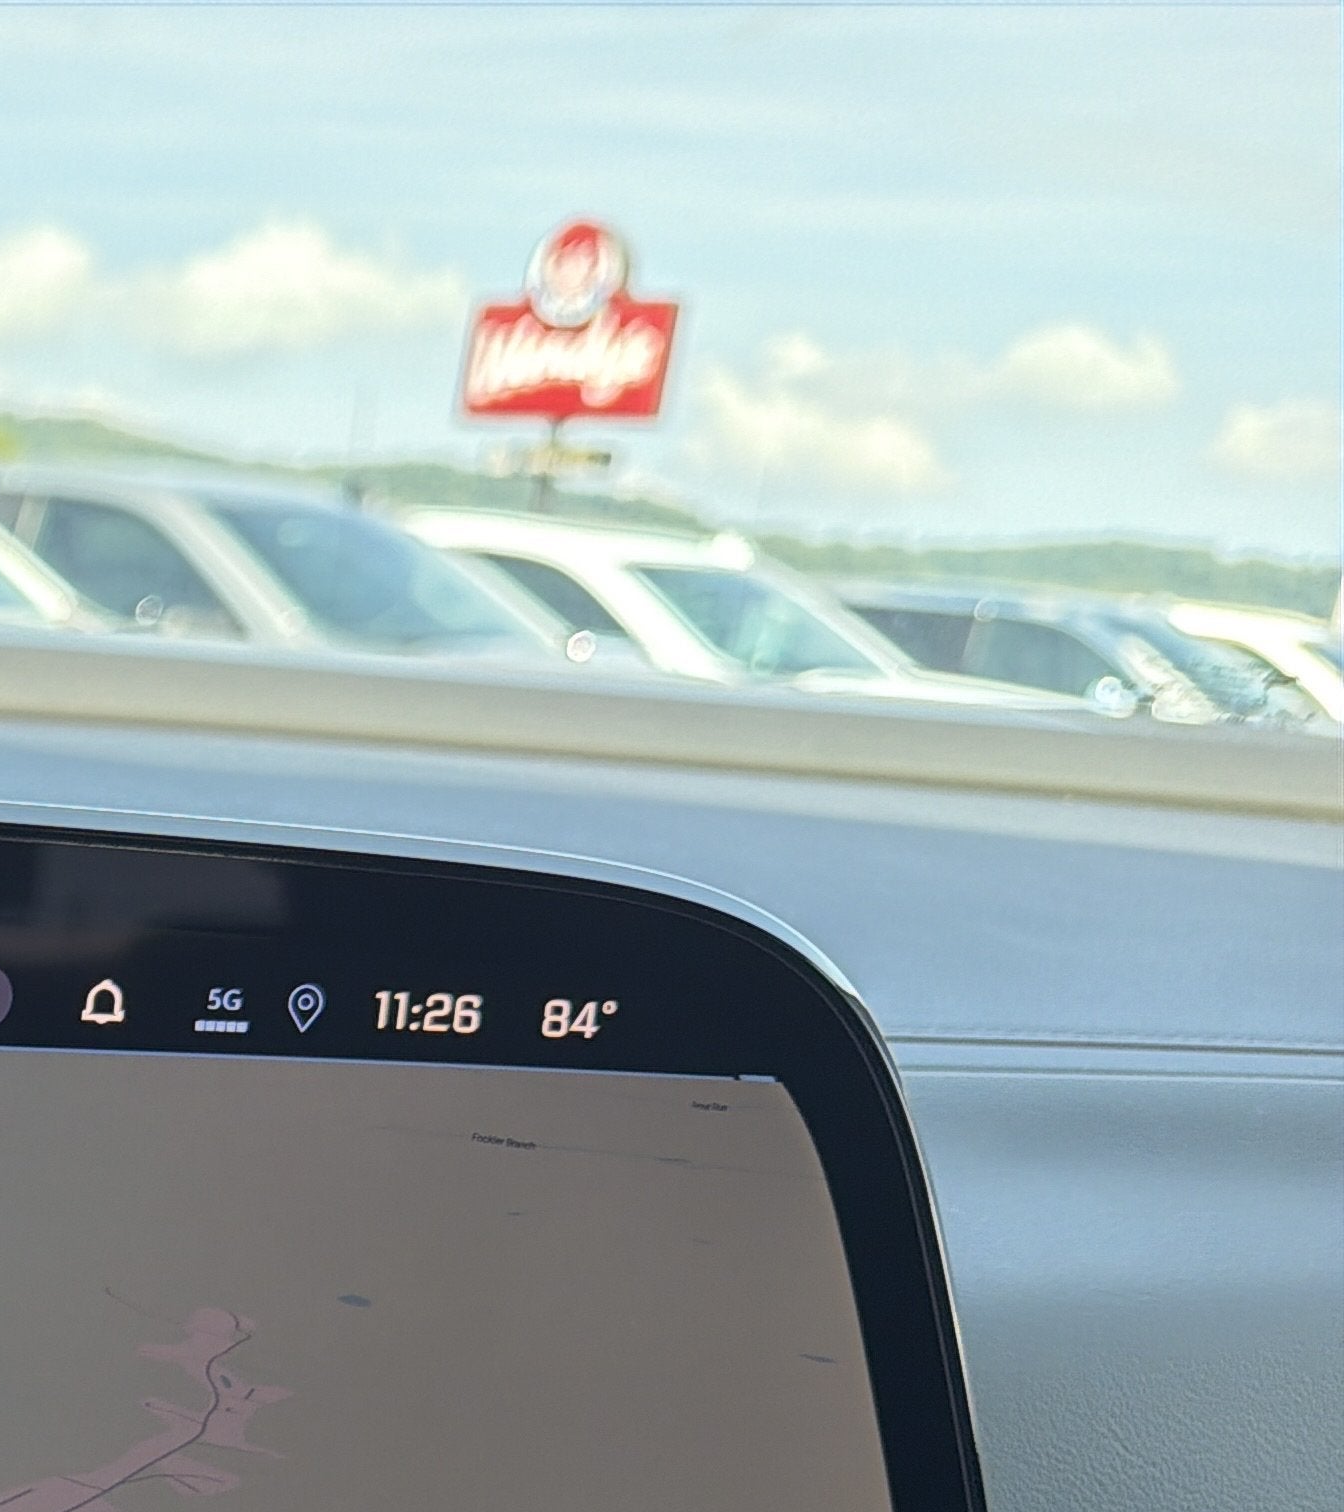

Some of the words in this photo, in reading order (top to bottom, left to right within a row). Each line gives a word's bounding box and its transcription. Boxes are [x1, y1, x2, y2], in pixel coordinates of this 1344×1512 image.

[208, 989, 241, 1010] 5G
[376, 991, 481, 1033] 11:26
[542, 1000, 617, 1038] 84°
